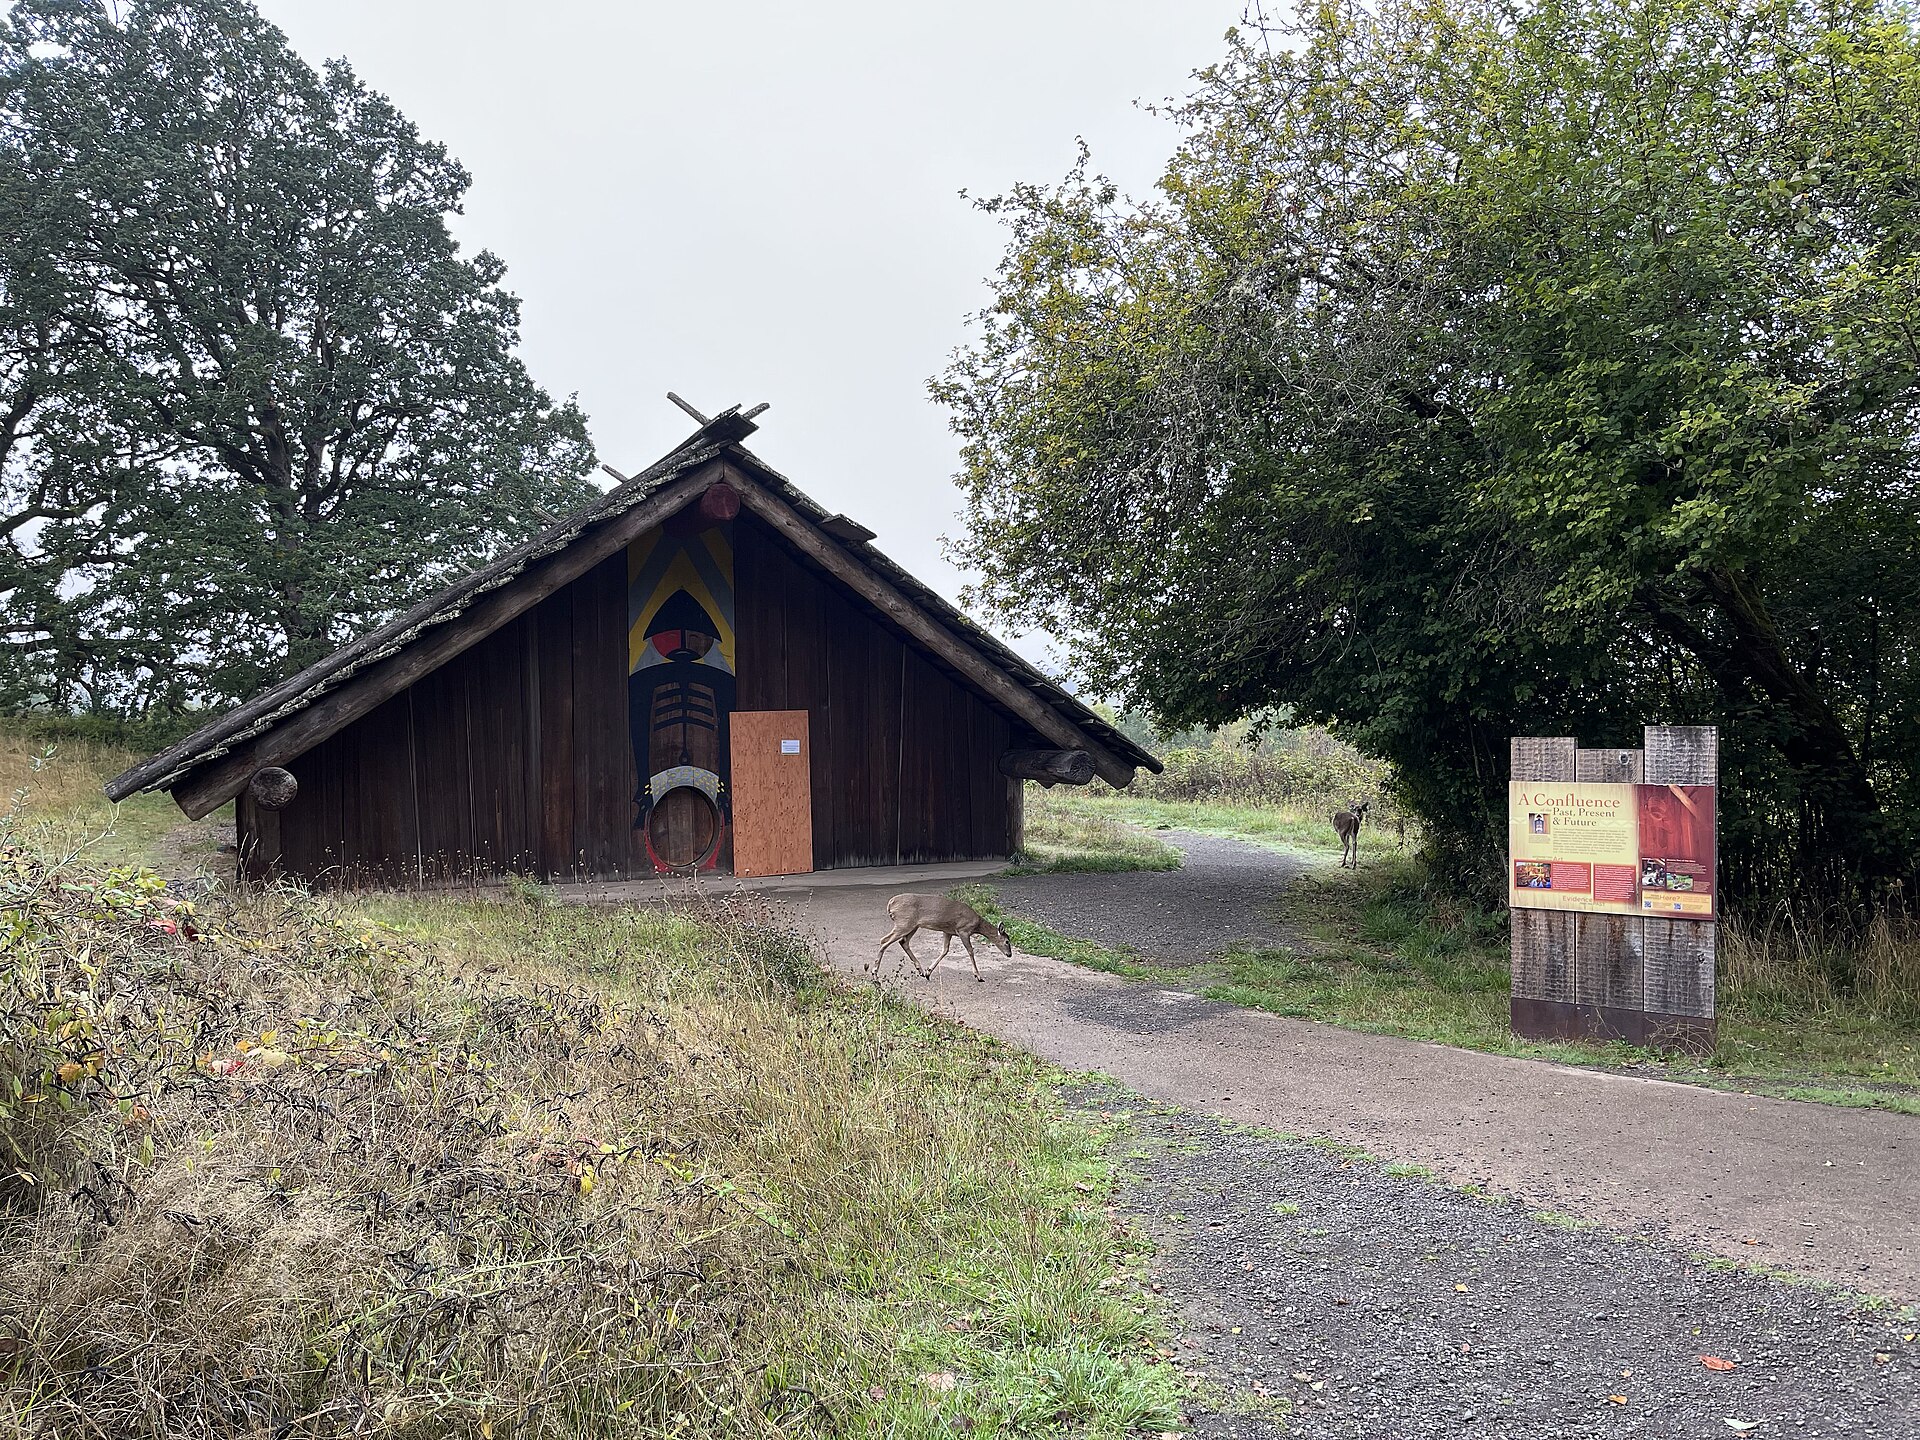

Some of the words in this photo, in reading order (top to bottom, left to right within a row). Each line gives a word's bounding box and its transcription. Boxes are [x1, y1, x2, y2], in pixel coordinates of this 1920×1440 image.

[1518, 793, 1530, 806] A
[1533, 792, 1621, 808] Confluence
[1553, 807, 1576, 817] Past,
[1578, 807, 1616, 818] Present
[1552, 817, 1561, 826] &
[1564, 817, 1597, 827] Future
[1562, 895, 1593, 903] Evidence
